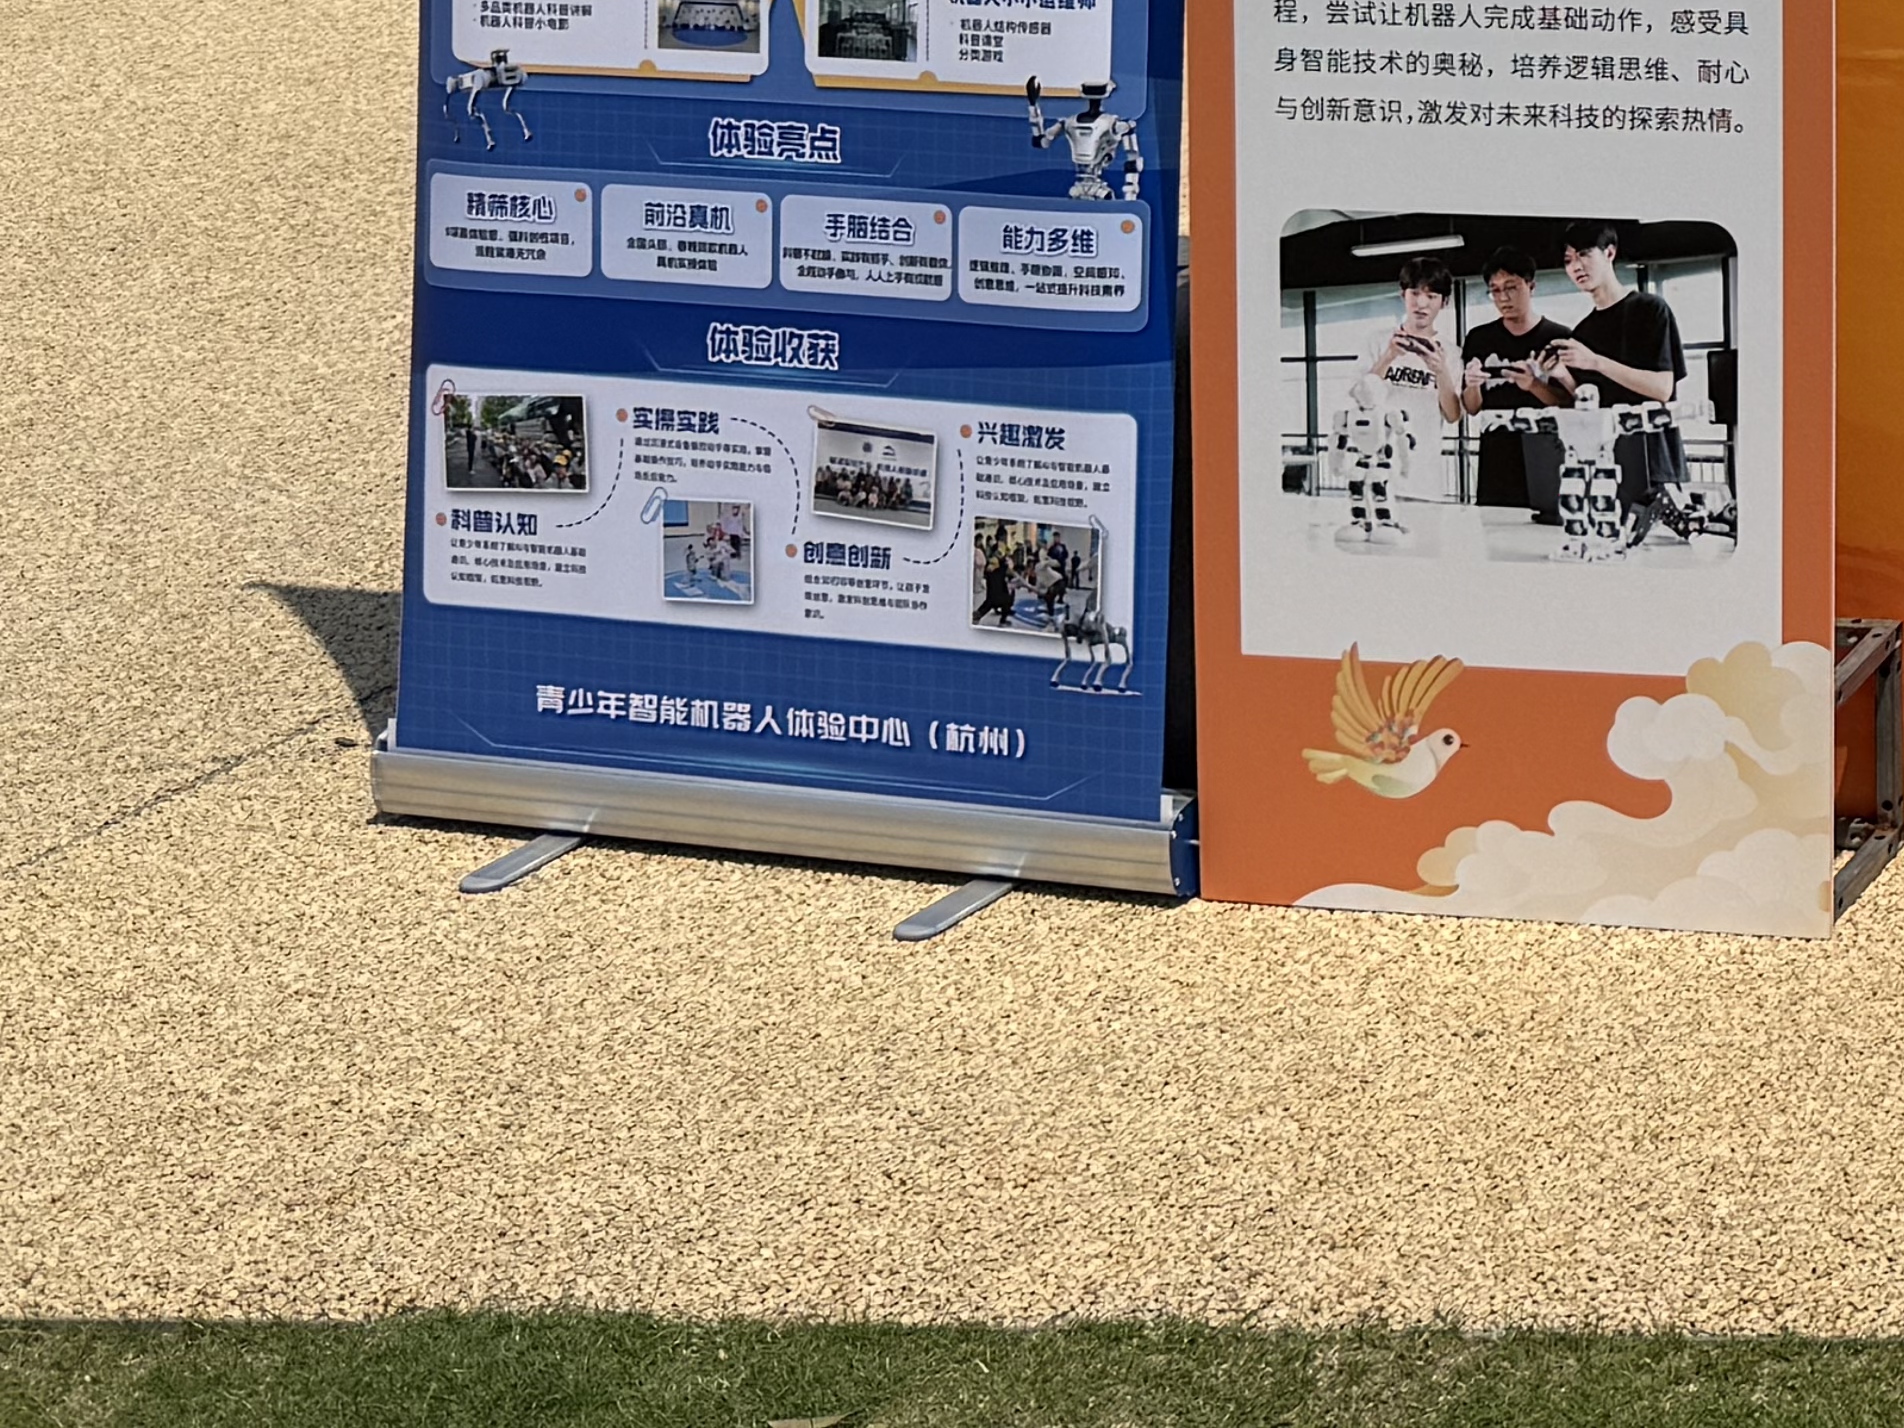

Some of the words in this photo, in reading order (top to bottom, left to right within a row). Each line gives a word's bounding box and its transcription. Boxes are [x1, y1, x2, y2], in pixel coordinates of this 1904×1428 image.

[1273, 0, 1750, 36] 程，尝试让机器人完成基础动作，感受具
[1274, 48, 1750, 85] 身智能技术的奥秘，培养逻辑思维、耐心
[708, 118, 841, 164] 体验亮点
[466, 191, 555, 222] 精筛核心
[643, 201, 734, 233] 前沿真机
[825, 212, 915, 245] 手脑结合
[1001, 224, 1098, 257] 能力多维
[707, 322, 841, 372] 体验收获
[632, 407, 720, 435] 实操实践
[977, 420, 1067, 451] 兴趣激发
[450, 508, 538, 537] 科普认知
[803, 540, 892, 571] 创意创新
[535, 684, 1027, 761] 青少年智能机器人体验中心（杭州）
